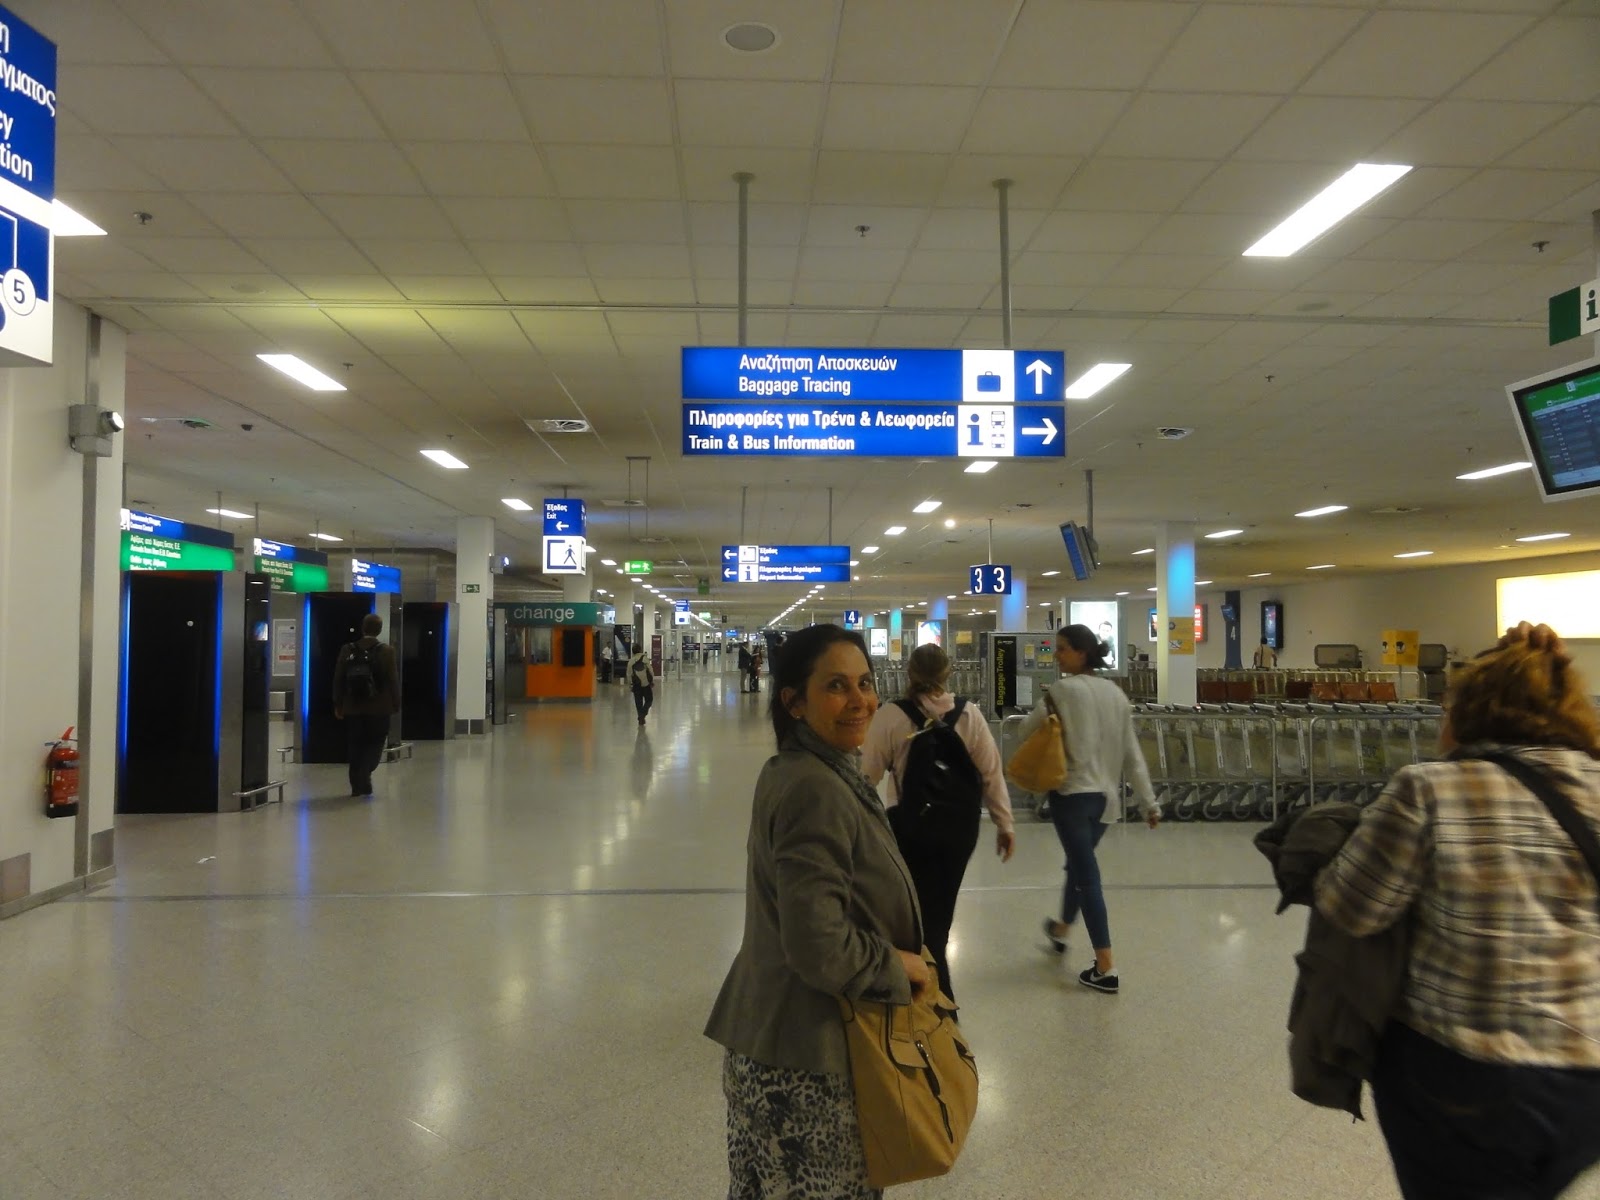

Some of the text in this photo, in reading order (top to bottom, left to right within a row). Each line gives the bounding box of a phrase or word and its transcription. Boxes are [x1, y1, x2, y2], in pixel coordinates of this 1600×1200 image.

[13, 278, 26, 305] 5
[739, 354, 897, 373] Αναζήτηση Αποσκευών
[738, 376, 851, 396] Baggage Tracing
[689, 410, 955, 431] Πληροφορίες για Τρένα & Λεωφορεία
[688, 433, 855, 450] Train & Bus Information
[546, 512, 557, 520] Exit
[974, 567, 983, 593] 3
[993, 567, 1005, 593] 3
[513, 605, 575, 623] change
[848, 611, 856, 623] 4
[996, 648, 1006, 706] Baggage Trolley
